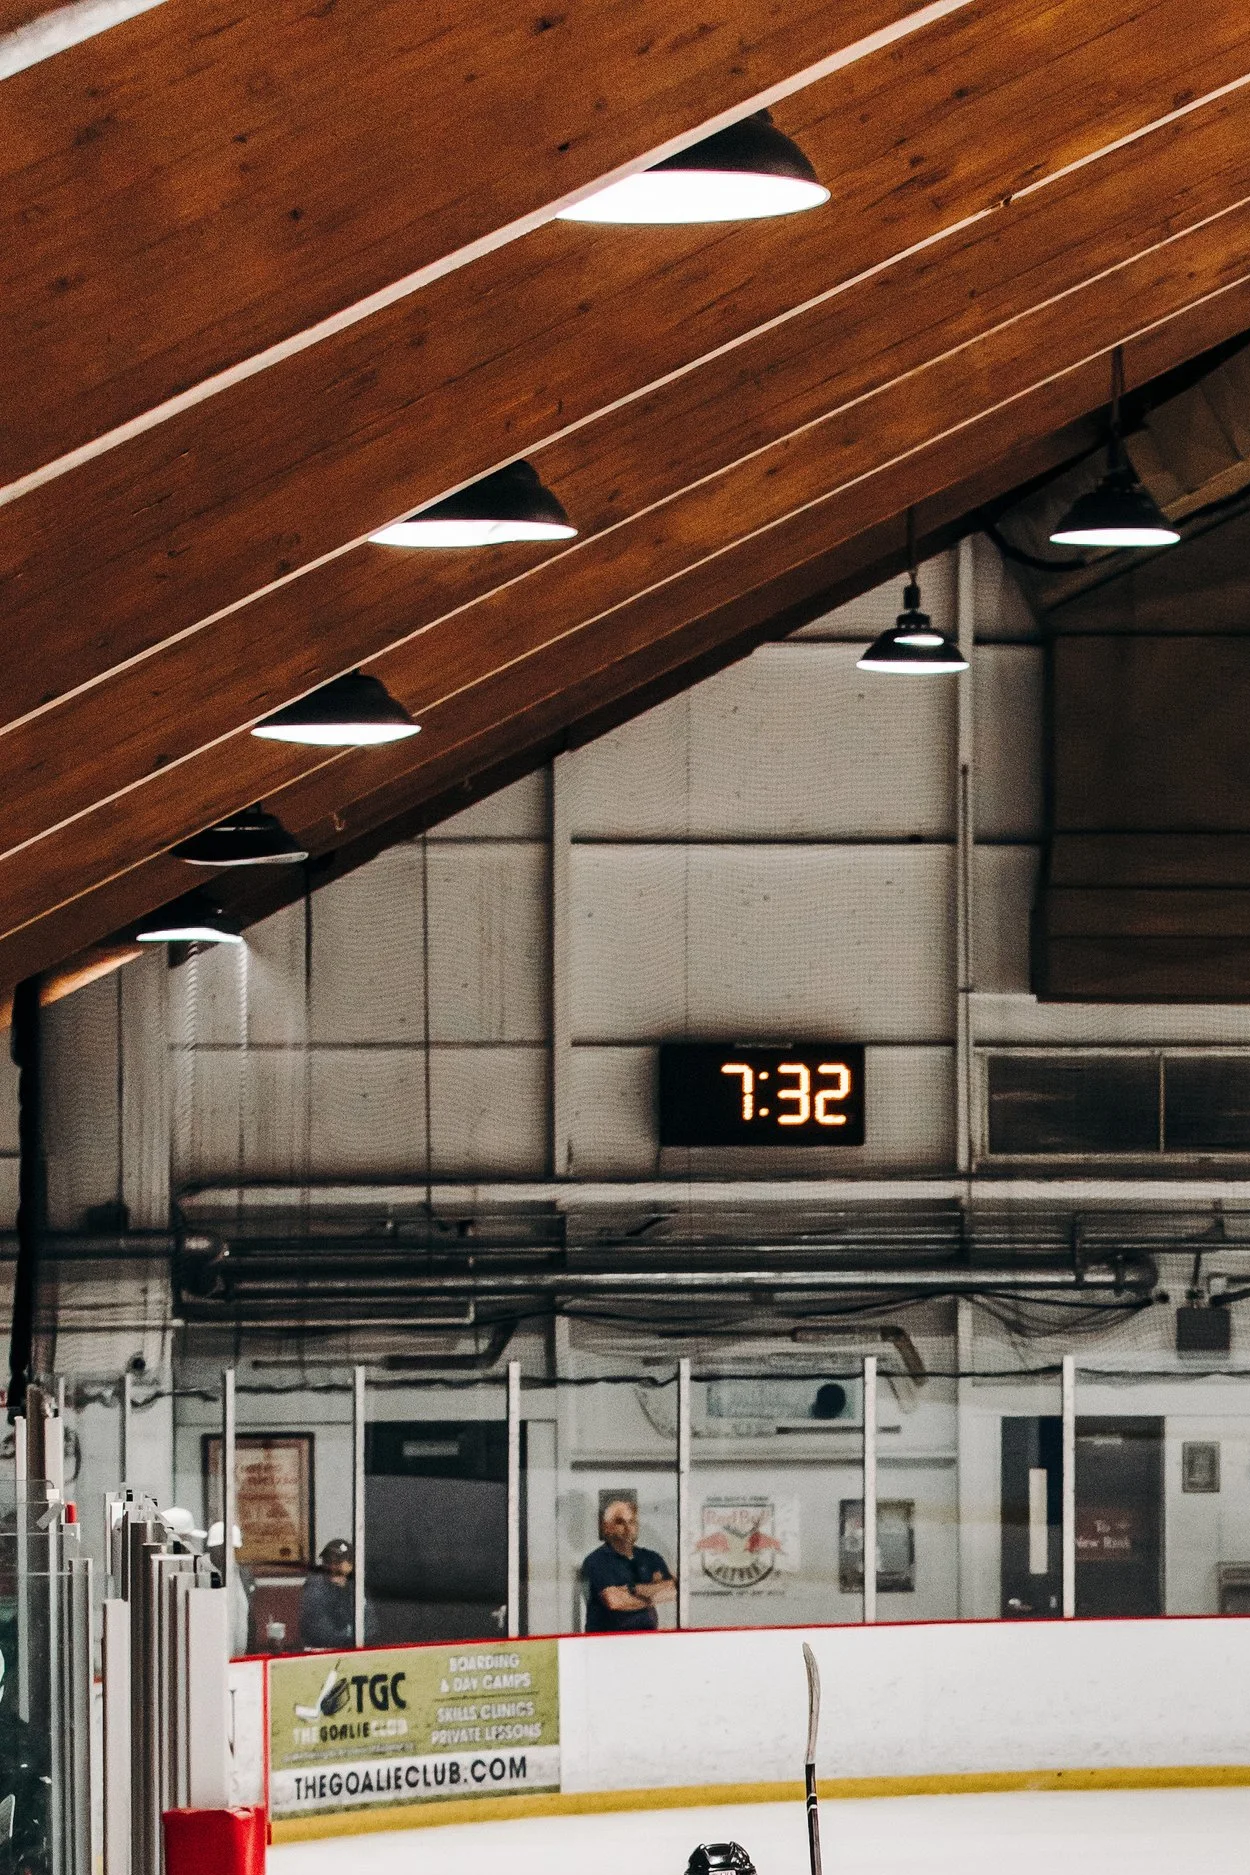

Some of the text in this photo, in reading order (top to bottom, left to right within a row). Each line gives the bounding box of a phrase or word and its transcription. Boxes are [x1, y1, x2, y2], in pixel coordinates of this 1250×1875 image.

[721, 1063, 851, 1126] 7:32
[449, 1653, 521, 1673] BOARDING
[351, 1672, 407, 1713] TGC
[453, 1676, 478, 1692] DAY
[481, 1671, 531, 1690] CAMPS
[436, 1701, 535, 1723] SKILLS CLINICS
[431, 1722, 542, 1745] PRIVATE LESSONS
[294, 1756, 528, 1800] THEGOALIECLUB.COM
